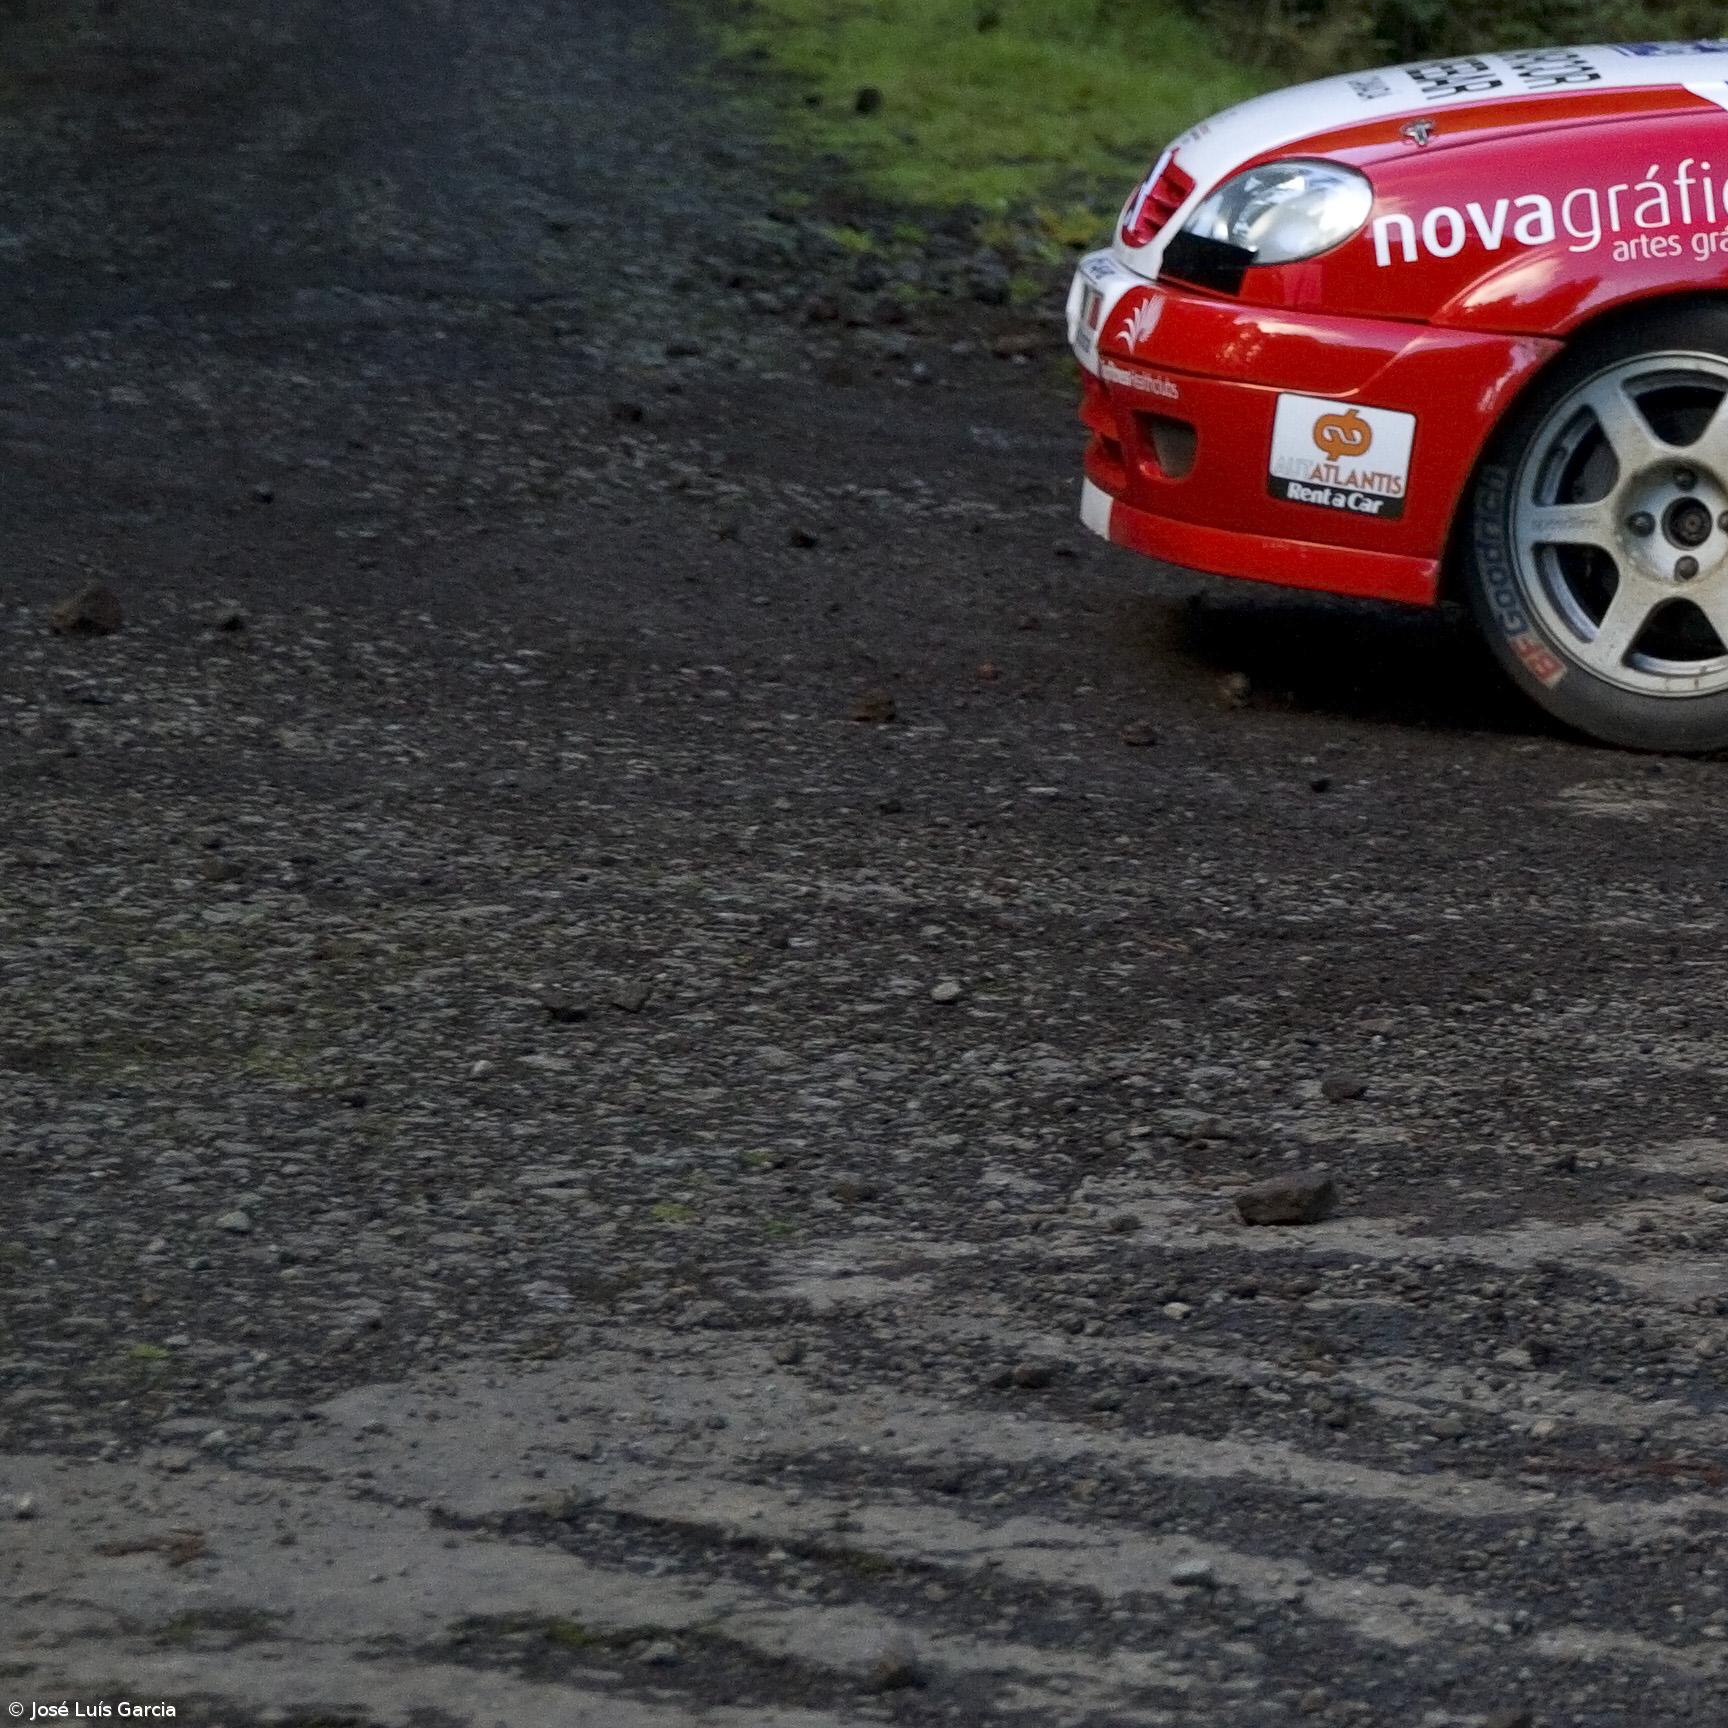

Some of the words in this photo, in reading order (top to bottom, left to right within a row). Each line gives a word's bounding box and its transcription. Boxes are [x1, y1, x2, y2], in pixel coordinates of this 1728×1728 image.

[1612, 231, 1683, 262] artes
[1286, 481, 1331, 506] Rent
[1332, 494, 1347, 509] a
[1348, 492, 1384, 514] Car
